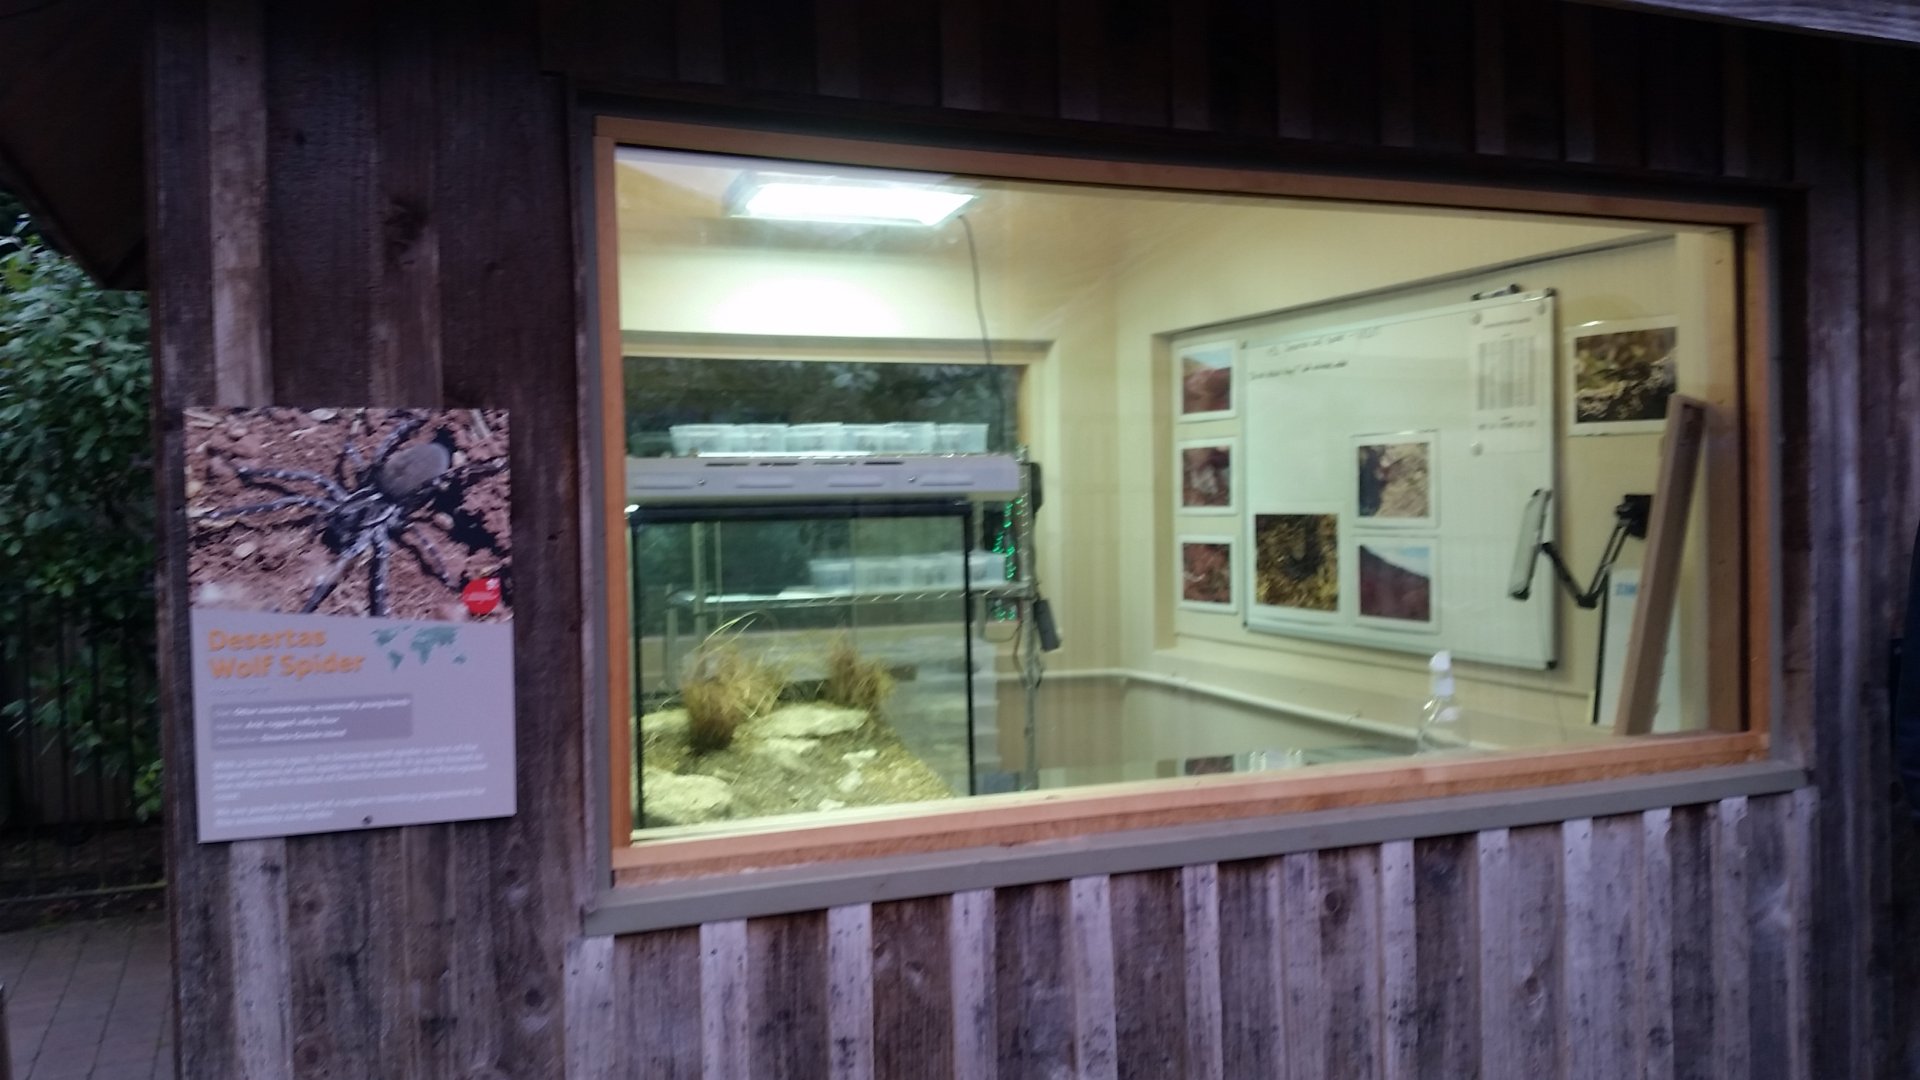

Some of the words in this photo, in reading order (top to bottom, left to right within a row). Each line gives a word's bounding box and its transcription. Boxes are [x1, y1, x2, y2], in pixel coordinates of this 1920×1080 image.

[208, 629, 327, 651] Desertas
[208, 655, 273, 679] Wolf
[280, 651, 366, 680] Spider
